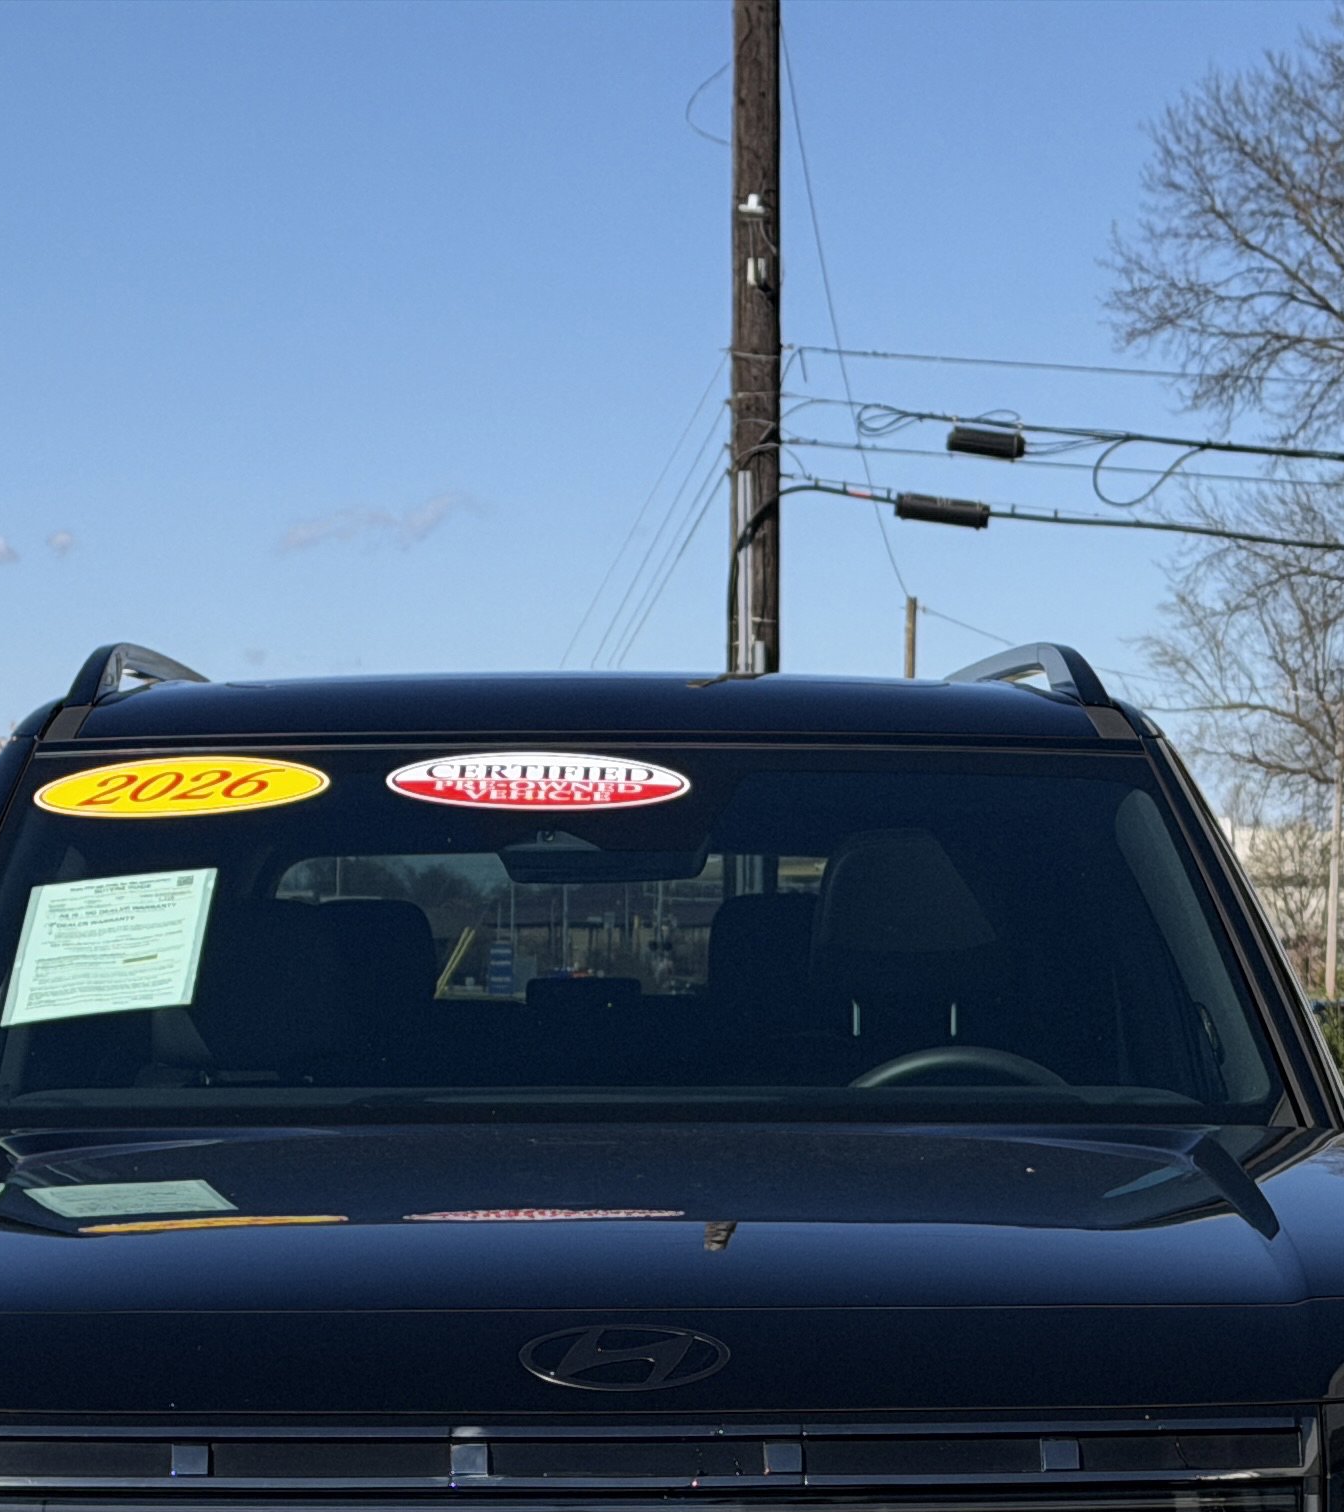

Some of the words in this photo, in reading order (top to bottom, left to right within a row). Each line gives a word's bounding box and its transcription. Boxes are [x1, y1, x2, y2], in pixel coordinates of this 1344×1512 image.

[426, 763, 654, 782] CERTIFIED
[76, 768, 286, 806] 2026
[434, 779, 643, 794] PRE-OWNED
[464, 789, 612, 802] VEHICLE
